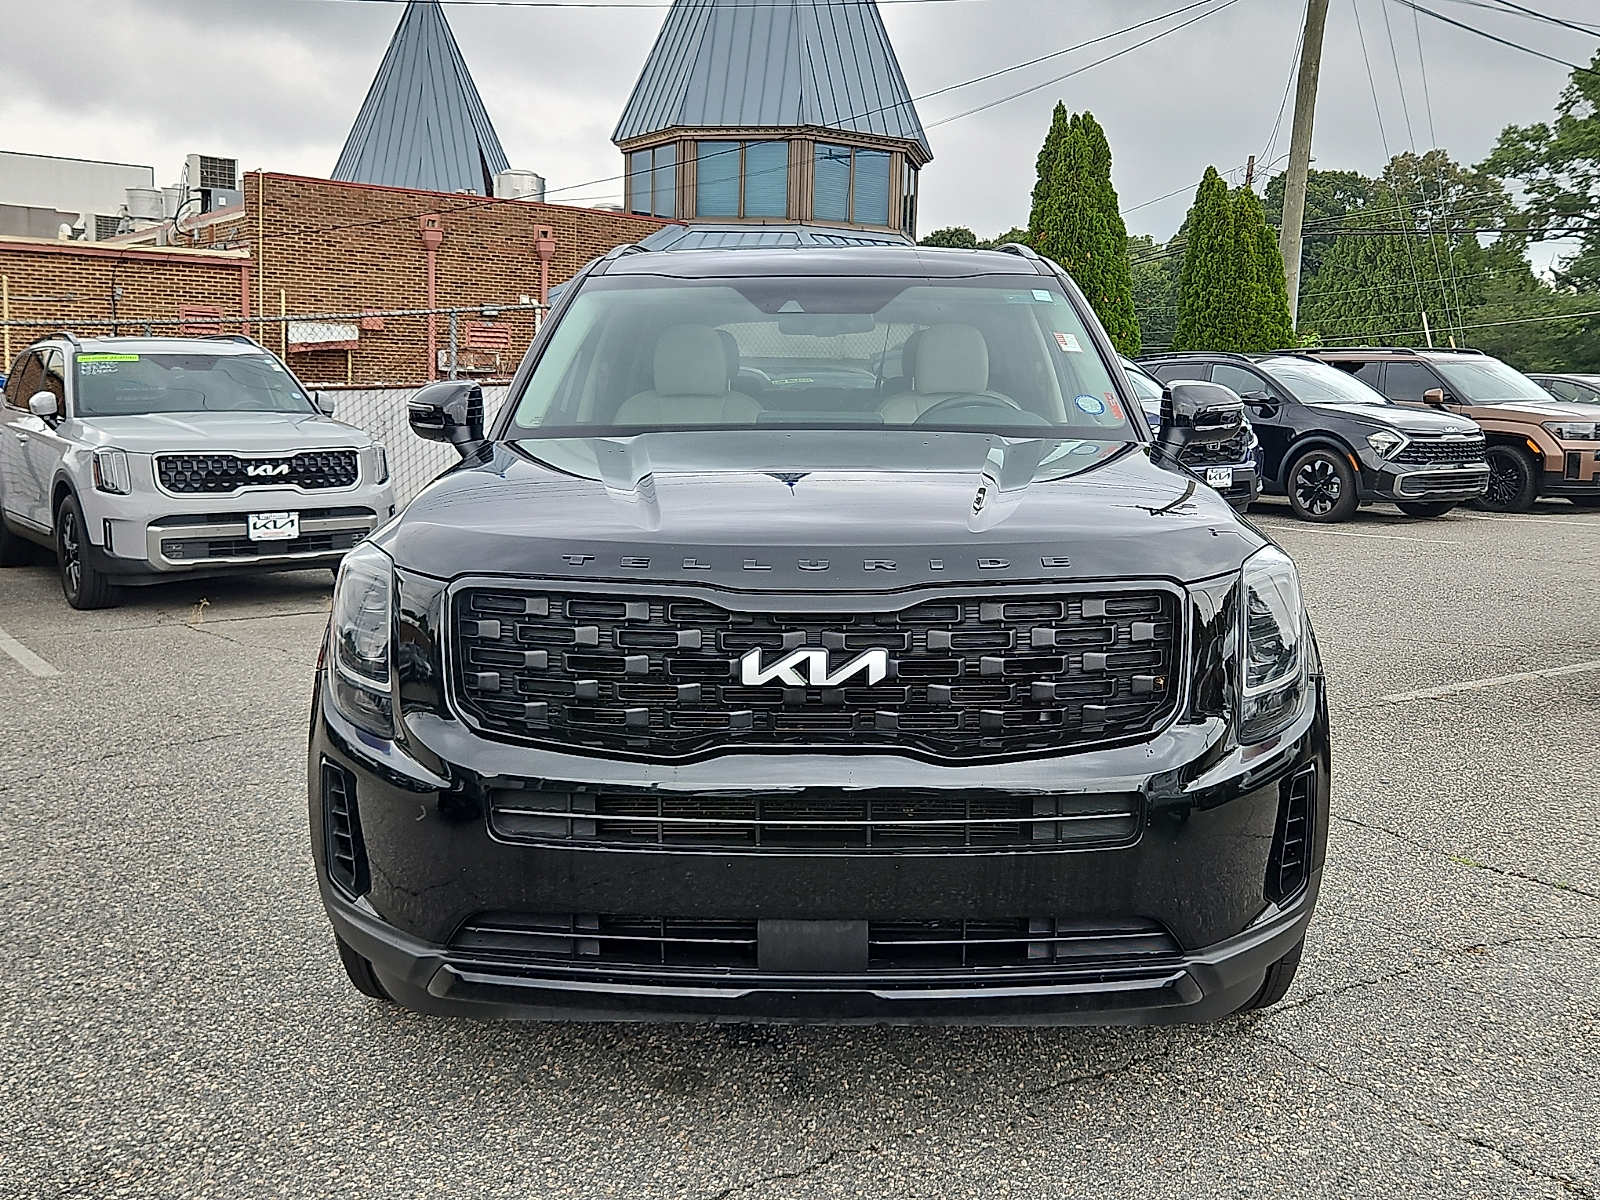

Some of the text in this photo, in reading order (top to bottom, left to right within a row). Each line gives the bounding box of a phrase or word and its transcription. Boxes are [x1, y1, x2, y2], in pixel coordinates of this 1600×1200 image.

[247, 464, 289, 477] KIA
[1208, 472, 1231, 481] KIA
[252, 519, 295, 530] KIA
[561, 554, 1071, 571] TELLURIDE
[740, 646, 889, 687] KIA
